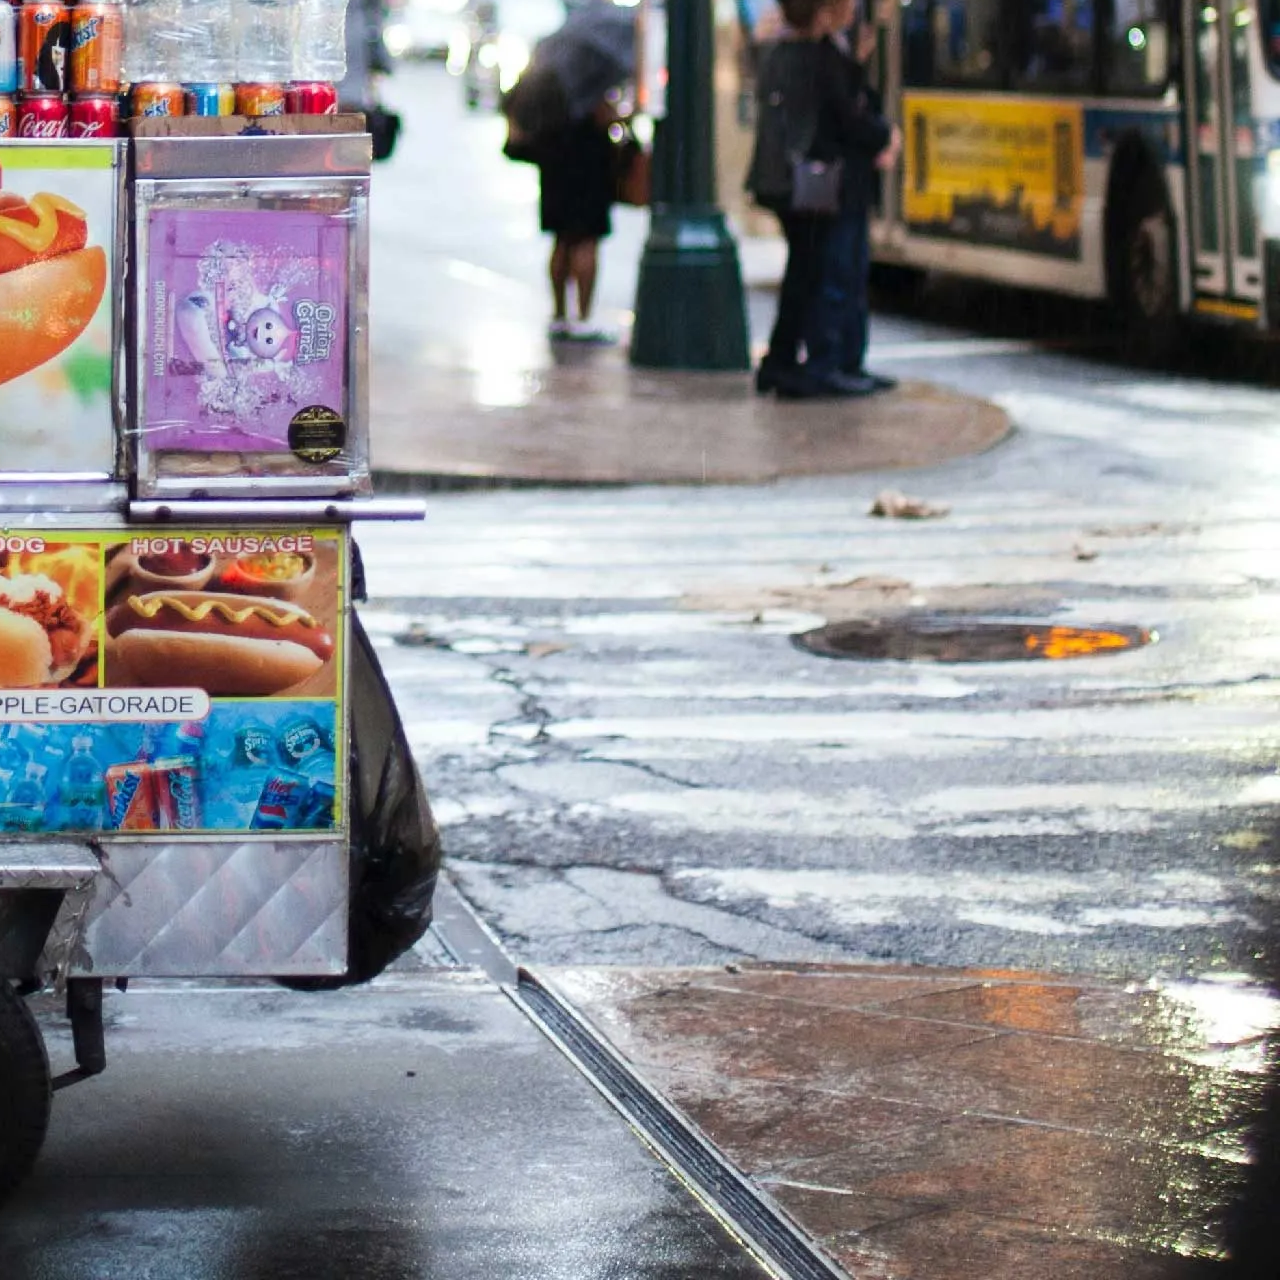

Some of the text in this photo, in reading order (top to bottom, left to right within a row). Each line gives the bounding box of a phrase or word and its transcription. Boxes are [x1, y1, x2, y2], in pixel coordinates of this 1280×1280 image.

[295, 300, 318, 363] Crunch
[314, 304, 336, 359] Onion
[131, 535, 314, 556] HOT SAUSAGE
